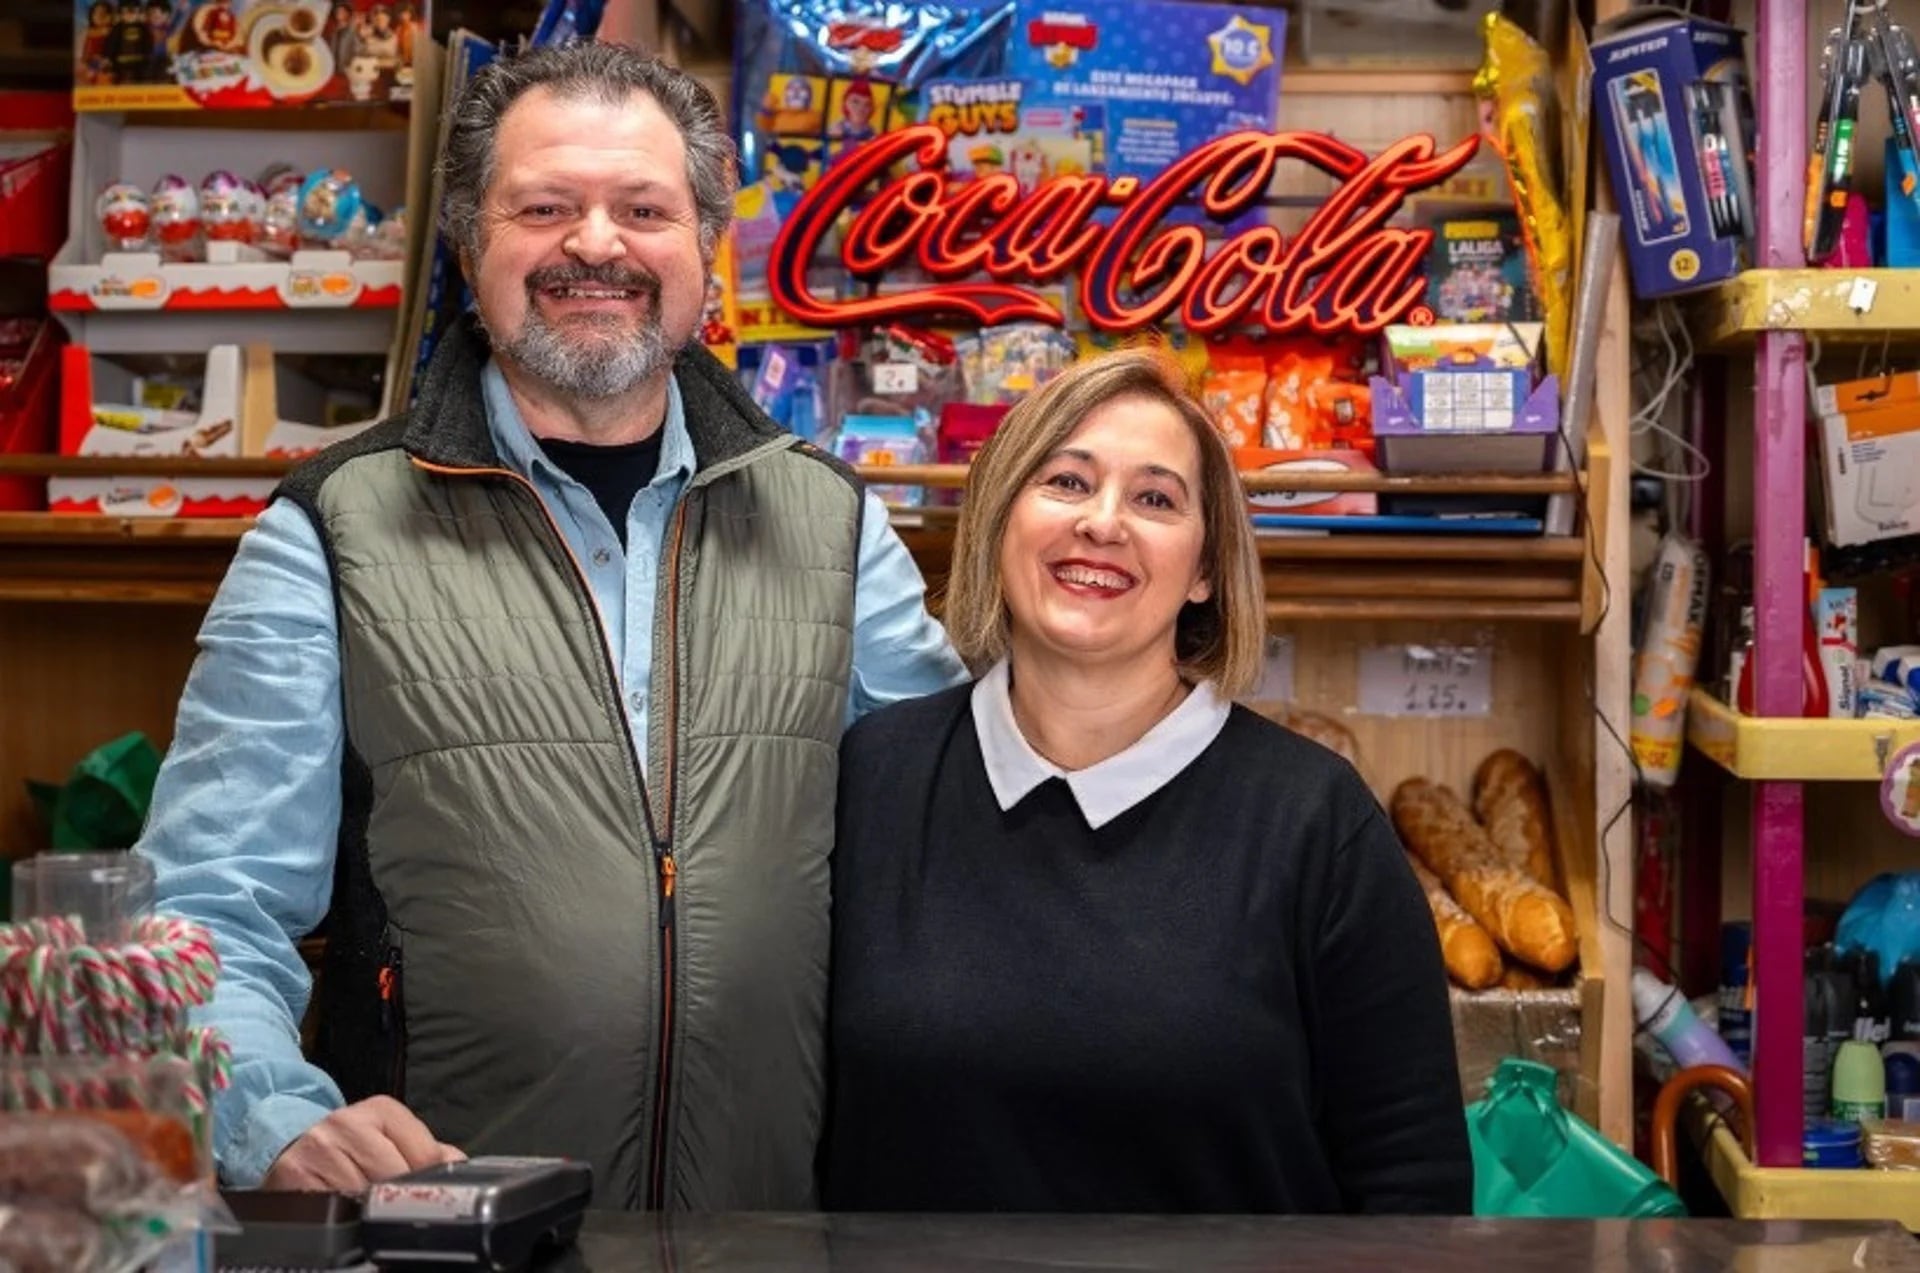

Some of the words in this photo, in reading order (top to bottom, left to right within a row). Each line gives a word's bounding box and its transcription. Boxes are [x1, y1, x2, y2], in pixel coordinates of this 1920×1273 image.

[930, 82, 1021, 105] STUMBLE
[929, 102, 1017, 138] GUYS
[1448, 239, 1504, 256] LALIGA
